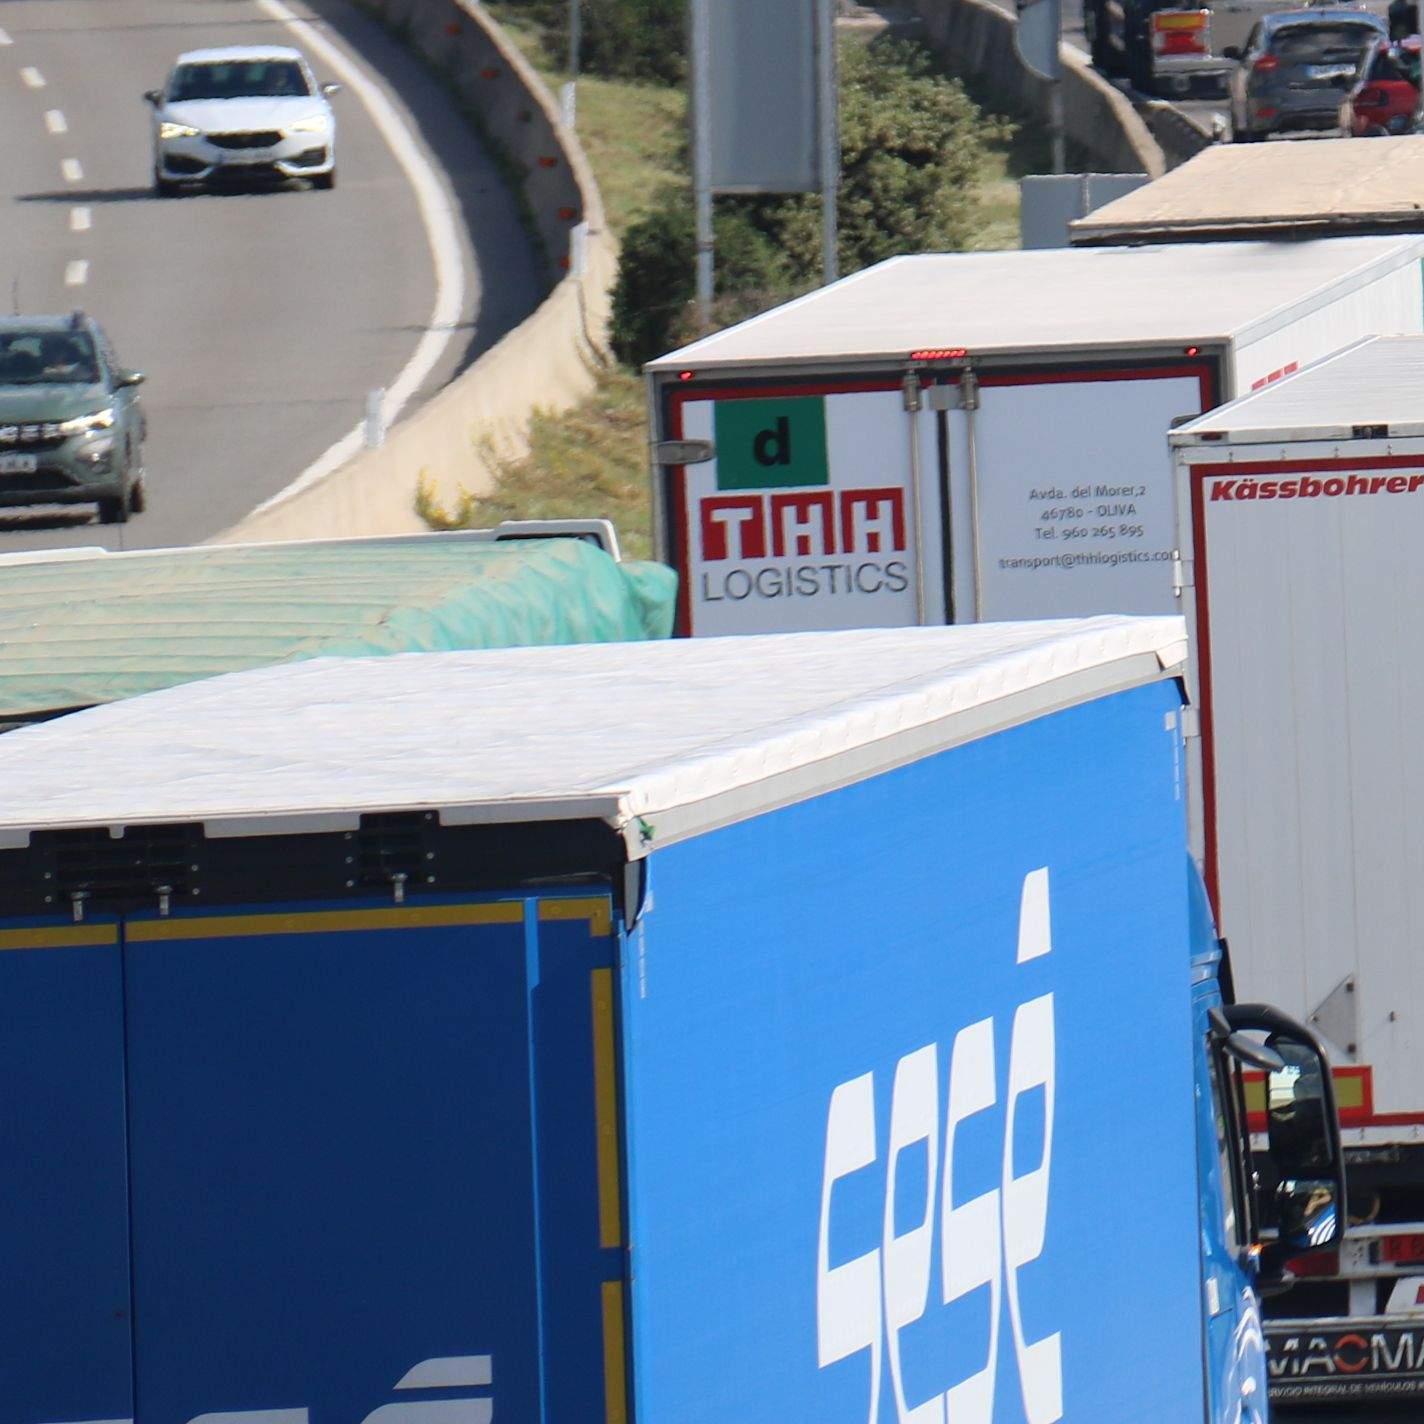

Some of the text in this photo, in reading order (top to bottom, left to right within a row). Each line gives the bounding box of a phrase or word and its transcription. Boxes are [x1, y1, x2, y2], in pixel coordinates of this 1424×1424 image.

[753, 416, 790, 465] d
[1029, 487, 1067, 499] Avda.
[1072, 486, 1091, 496] del
[1210, 474, 1424, 501] Kässbohrer
[1041, 508, 1084, 520] 46780
[1098, 504, 1137, 517] OLIVA
[1062, 529, 1088, 540] 960
[1092, 526, 1116, 538] 265
[1119, 524, 1144, 536] 895
[703, 562, 909, 602] LOGISTICS
